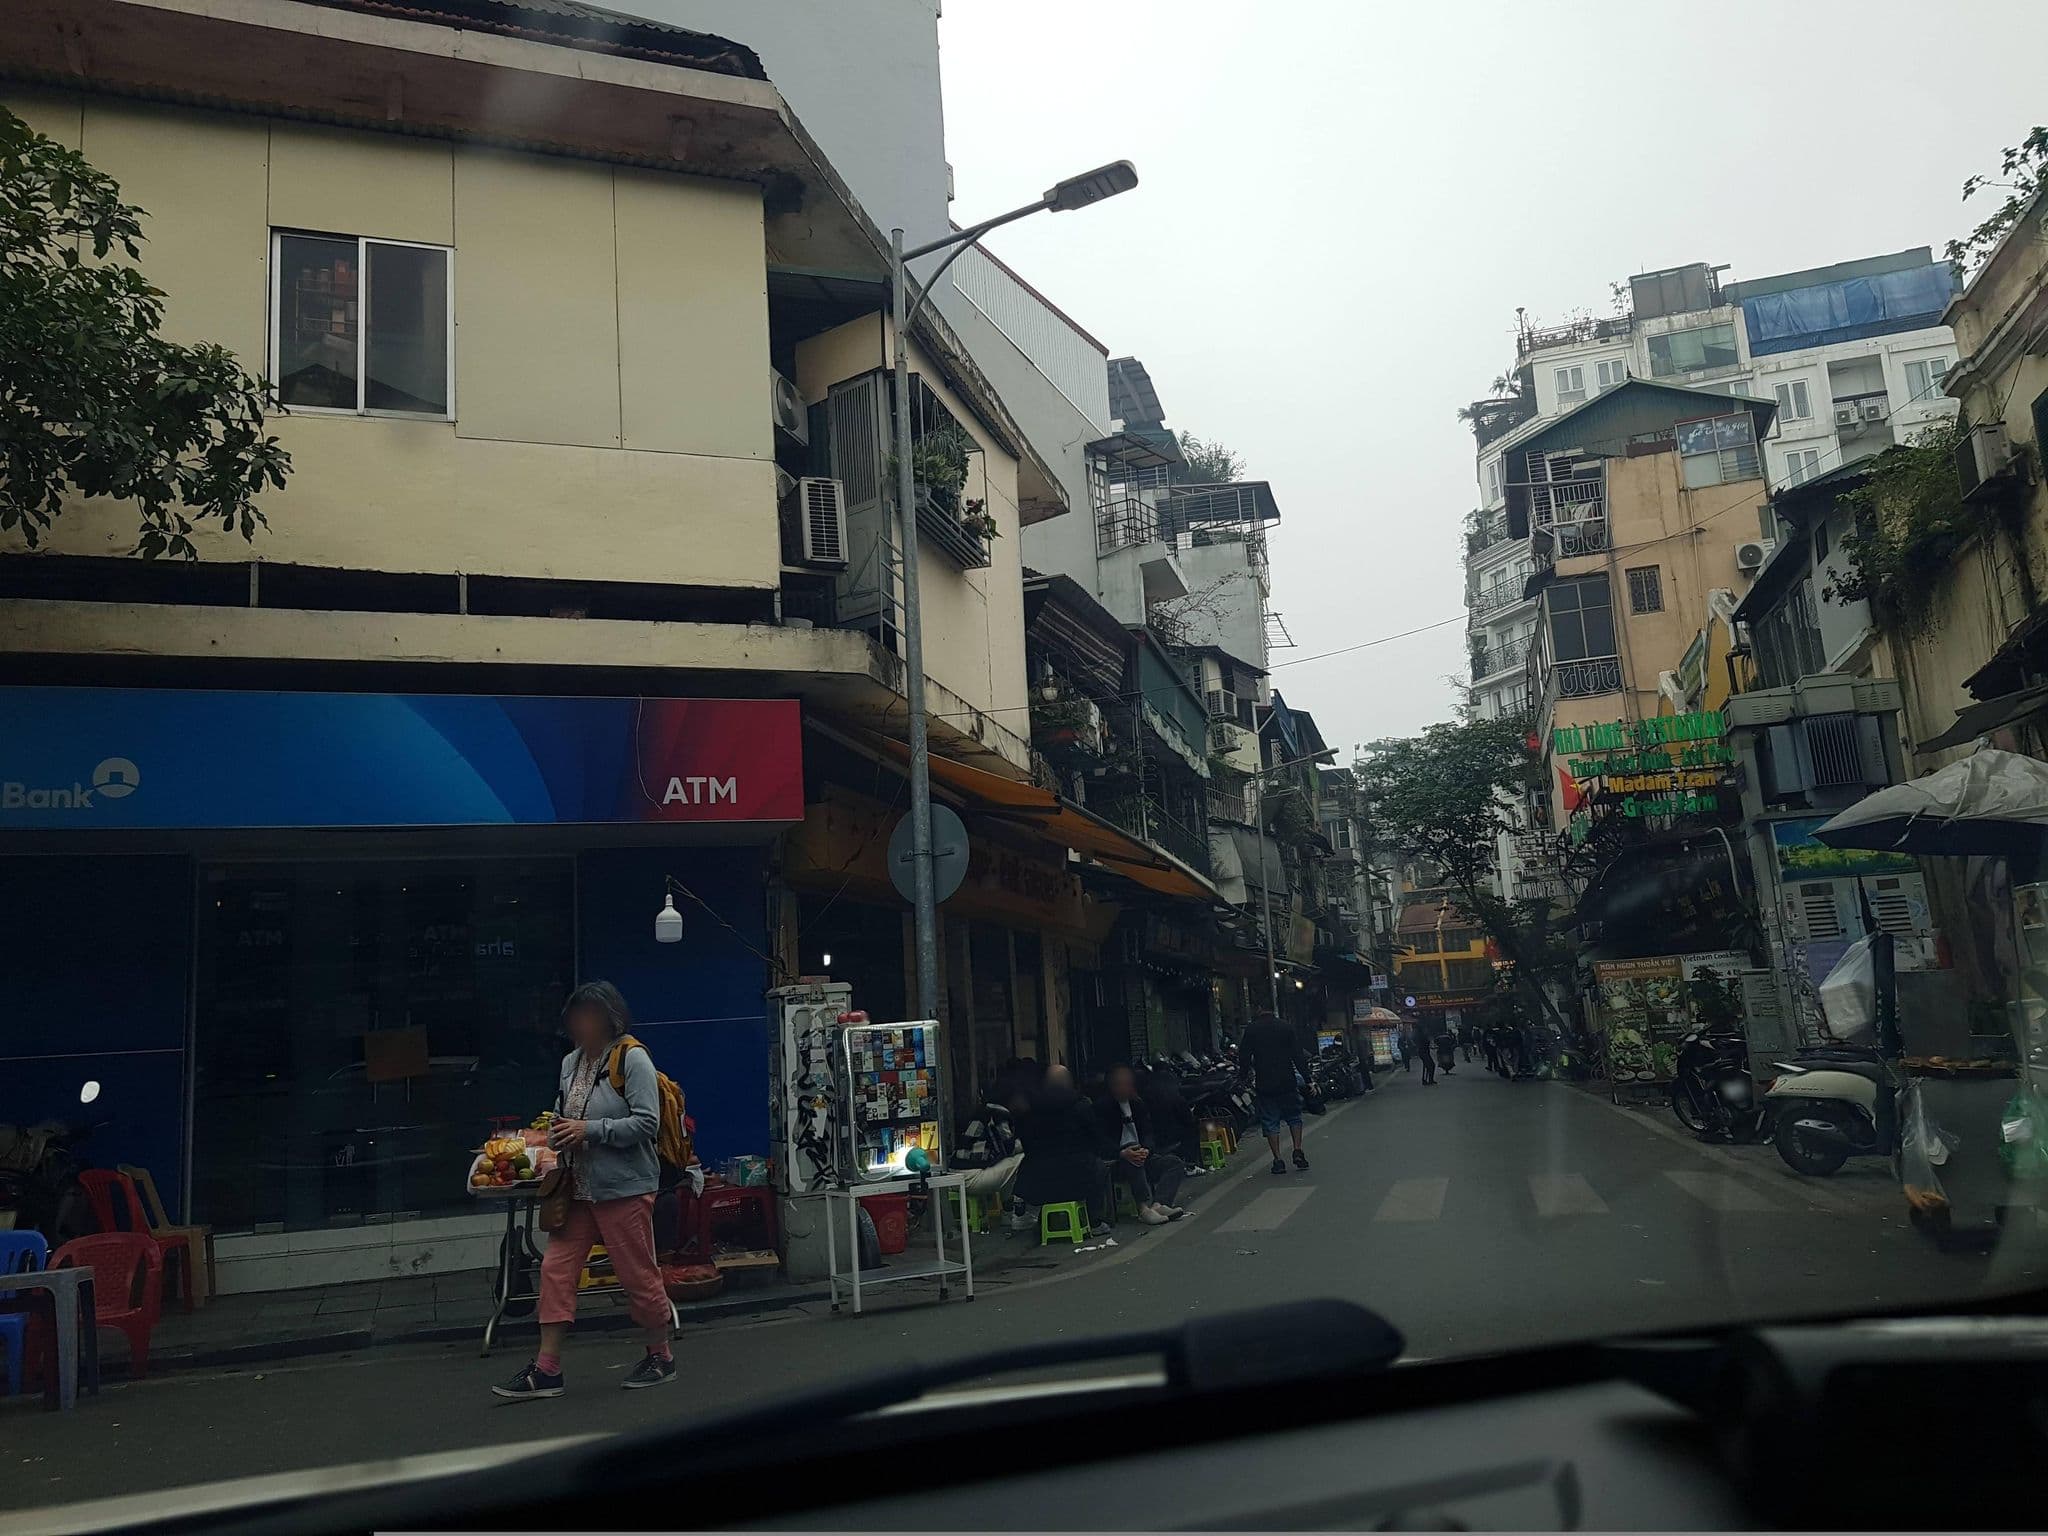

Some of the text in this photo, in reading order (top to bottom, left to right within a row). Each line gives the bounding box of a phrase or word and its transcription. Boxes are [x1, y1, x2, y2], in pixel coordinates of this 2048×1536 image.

[2, 782, 95, 808] Bank
[662, 776, 738, 804] ATM
[1608, 775, 1671, 793] Madam
